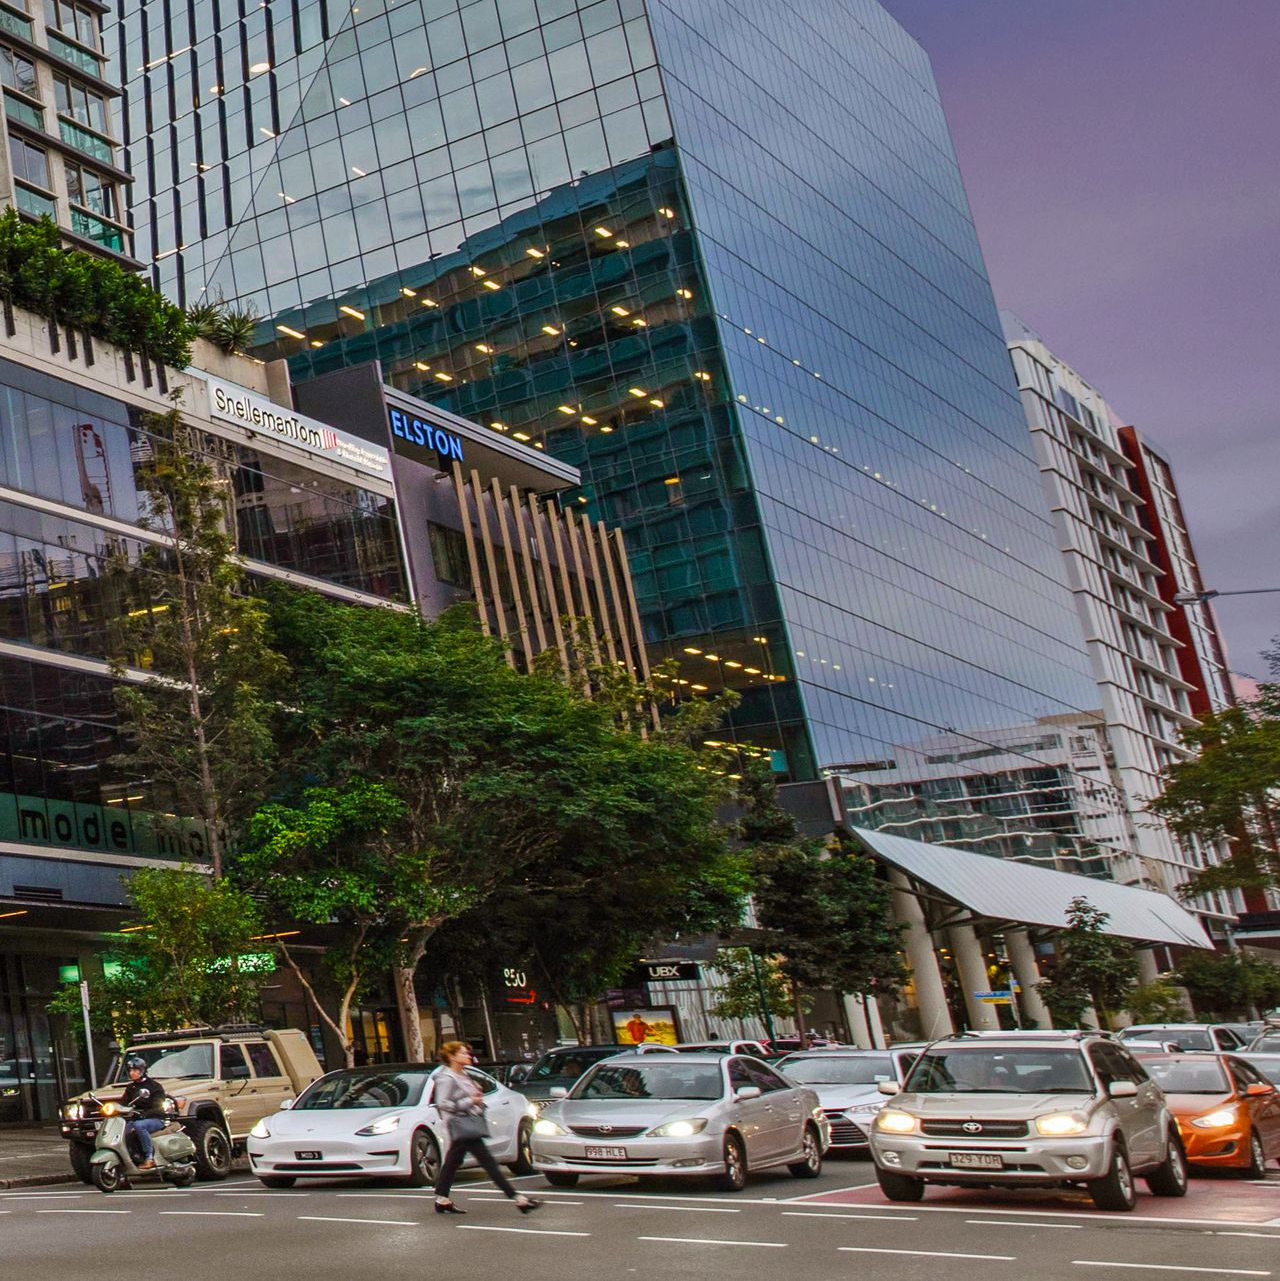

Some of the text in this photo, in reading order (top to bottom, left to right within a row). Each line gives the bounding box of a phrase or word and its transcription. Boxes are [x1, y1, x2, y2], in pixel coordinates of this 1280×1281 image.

[390, 409, 465, 464] ELSTON
[19, 809, 129, 850] mode
[648, 966, 680, 977] UBX
